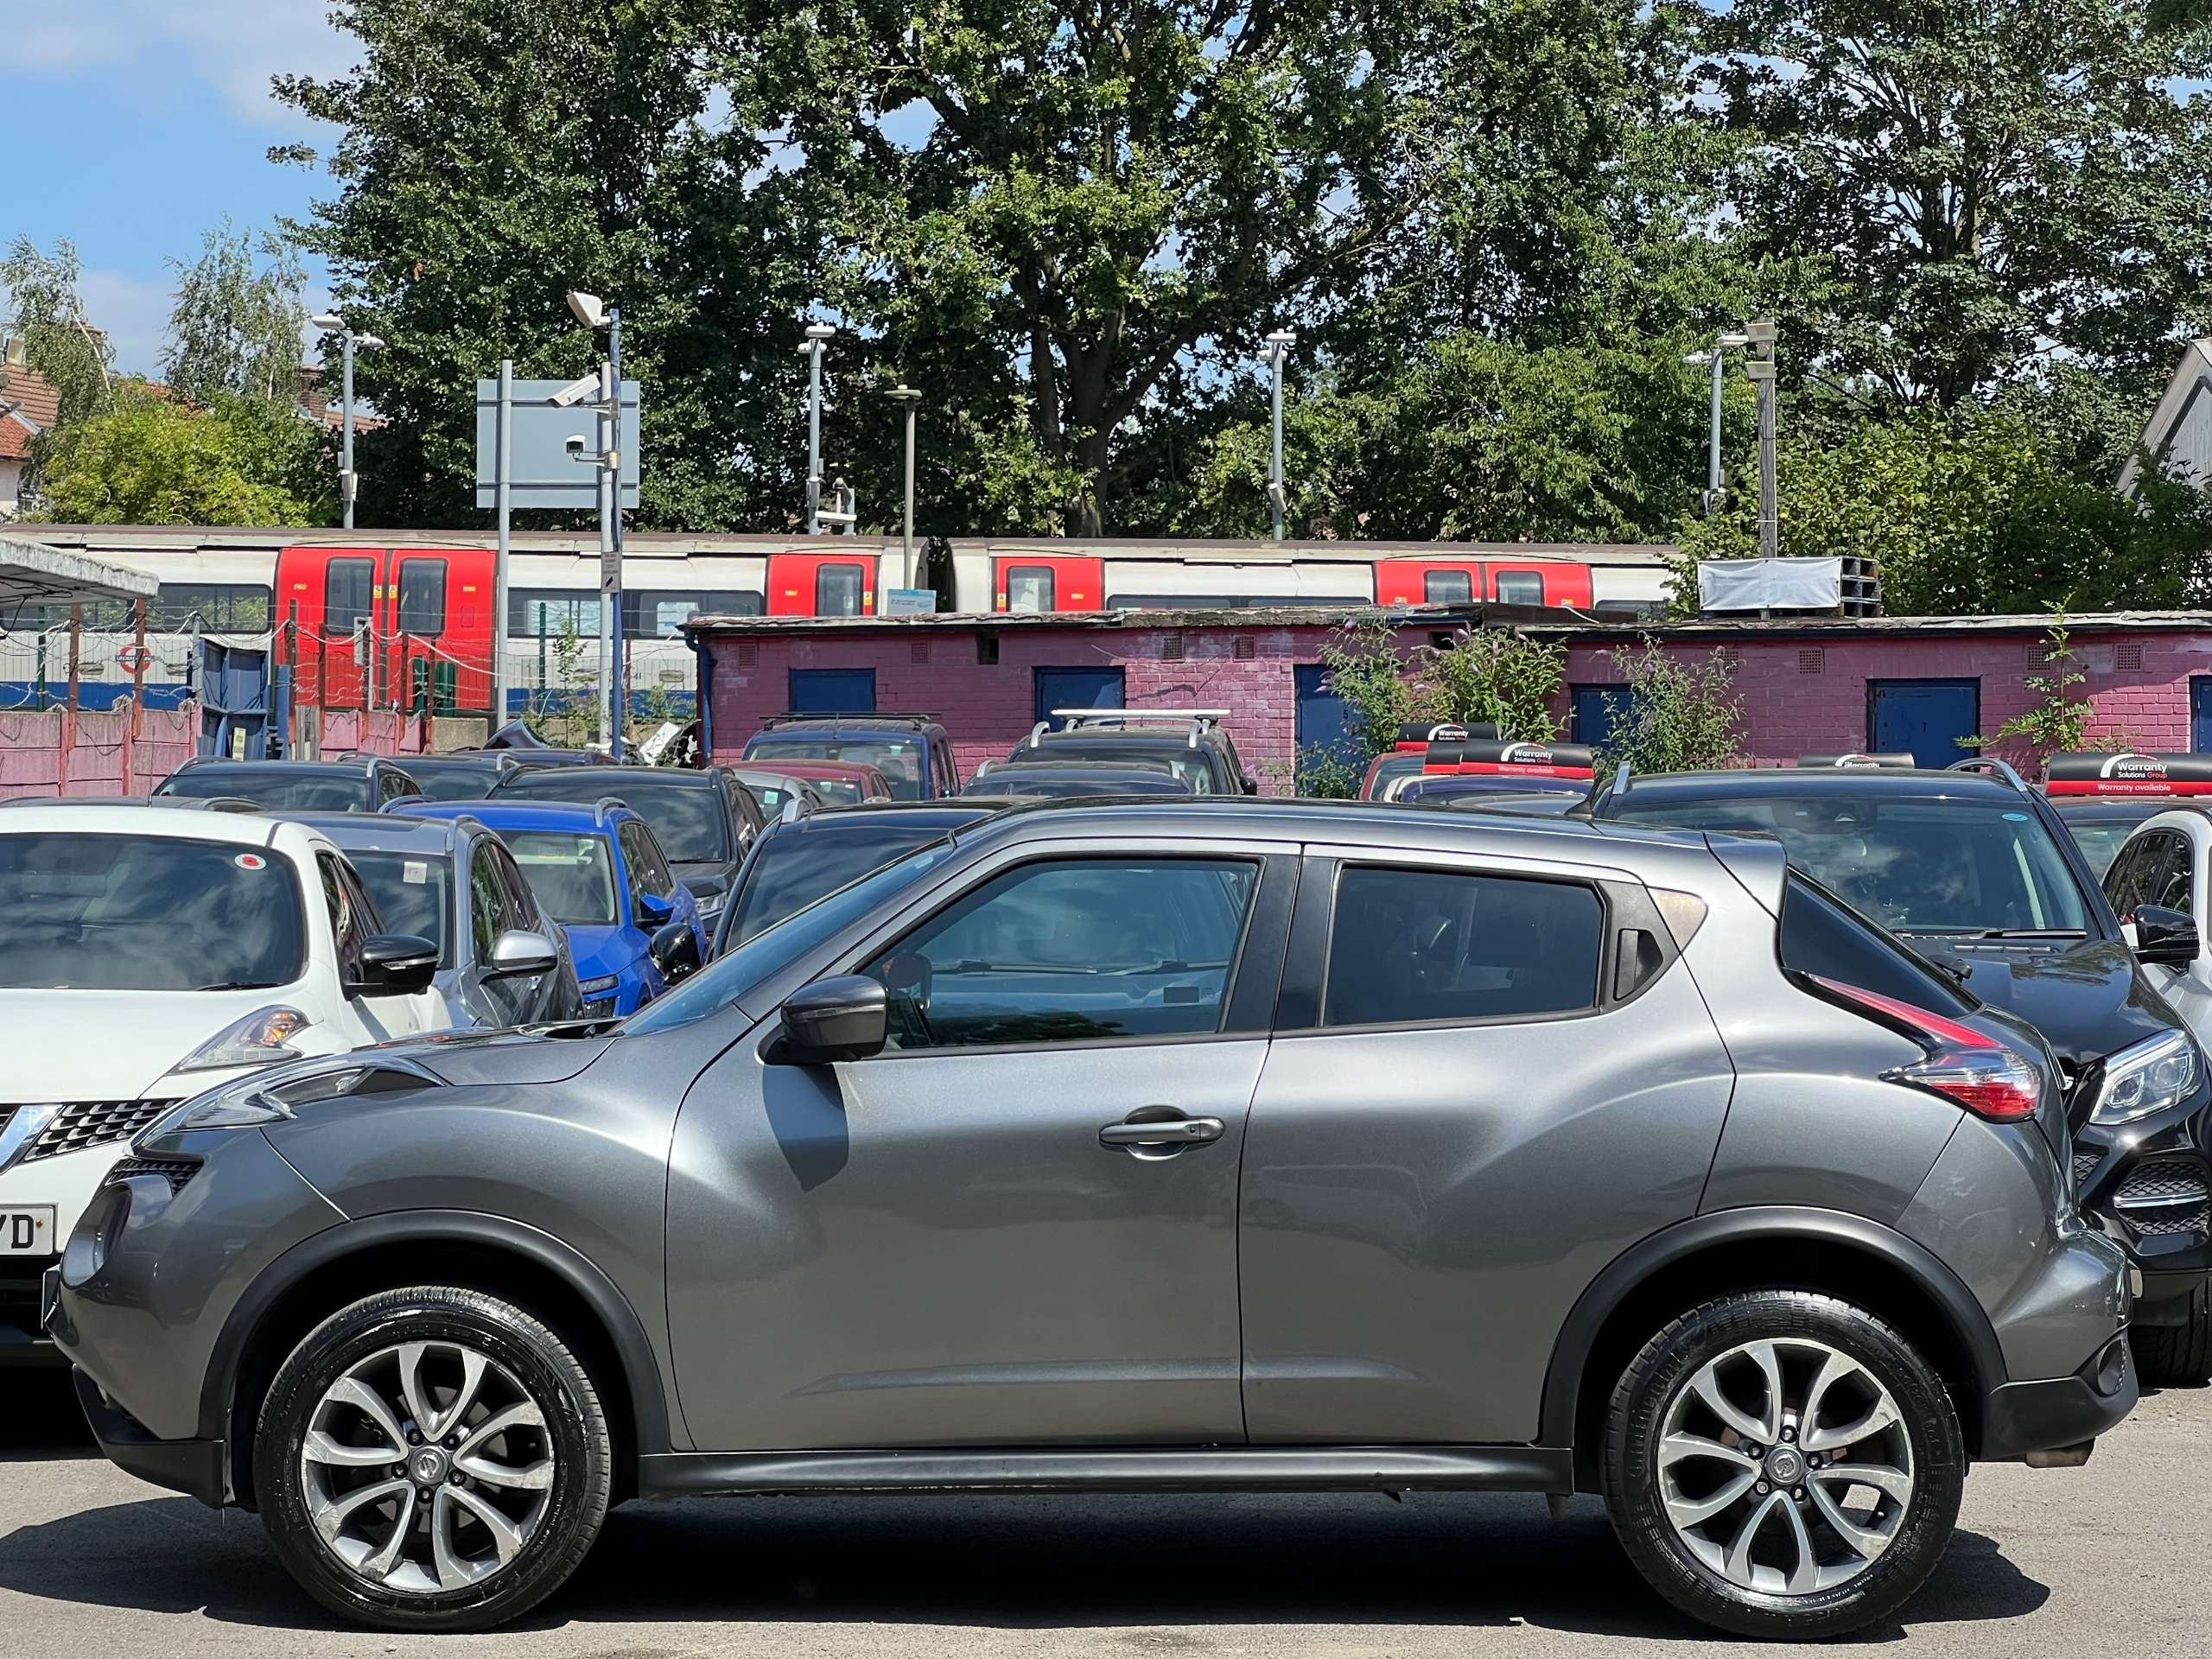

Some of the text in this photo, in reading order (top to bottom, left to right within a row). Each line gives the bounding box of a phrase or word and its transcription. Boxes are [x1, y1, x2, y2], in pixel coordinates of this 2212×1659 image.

[1514, 749, 1553, 760] Warranty
[2117, 762, 2167, 772] Warranty
[2098, 783, 2171, 792] Warranty available
